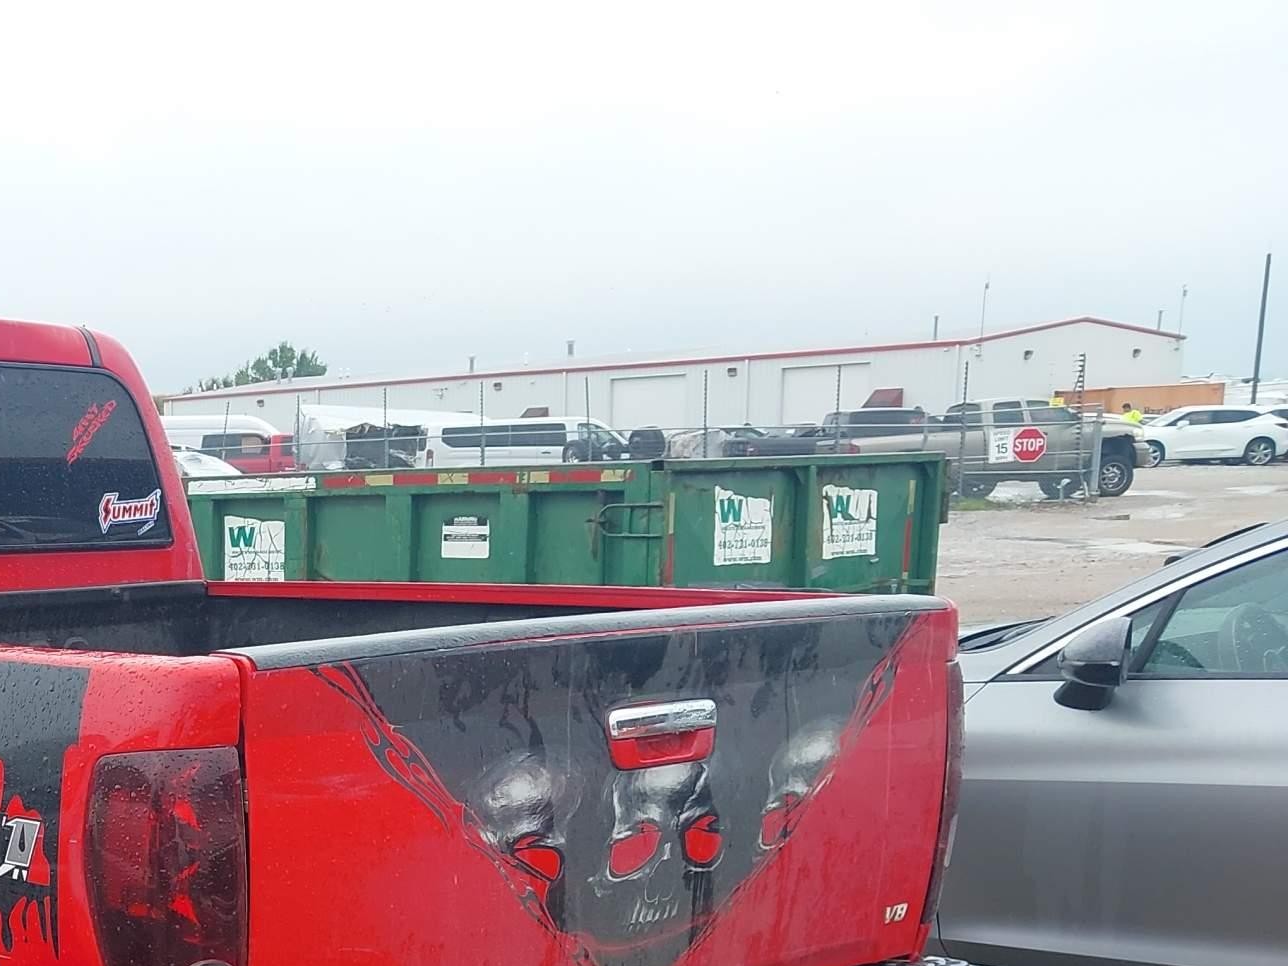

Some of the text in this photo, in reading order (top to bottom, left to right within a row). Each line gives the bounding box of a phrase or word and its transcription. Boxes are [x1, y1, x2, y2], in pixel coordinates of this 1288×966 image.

[995, 443, 1008, 454] 15
[1014, 438, 1044, 452] STOP
[719, 498, 744, 524] W
[228, 526, 255, 548] W
[884, 903, 909, 924] V8
